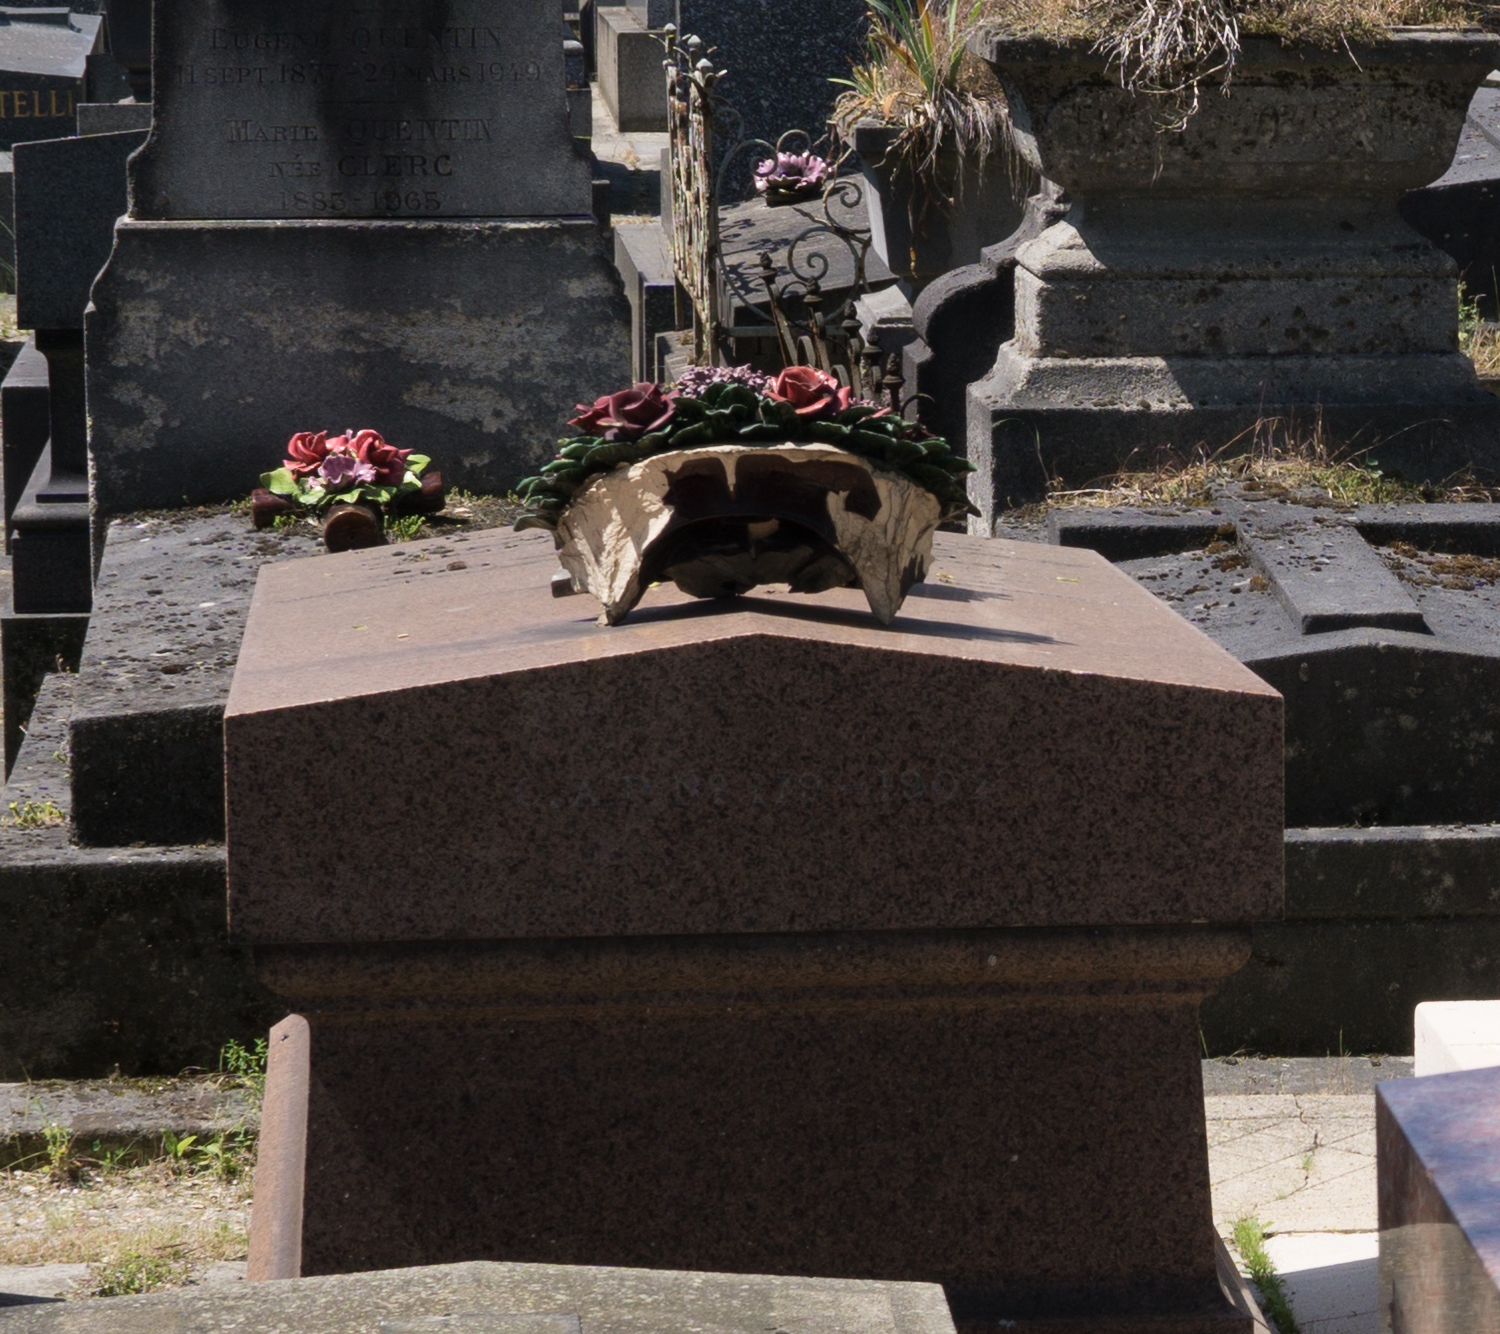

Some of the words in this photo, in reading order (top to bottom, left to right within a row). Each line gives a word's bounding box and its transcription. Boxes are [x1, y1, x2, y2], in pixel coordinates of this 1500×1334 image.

[351, 25, 503, 54] QUENTIN
[225, 118, 319, 143] MARIE
[345, 118, 493, 147] QUENTIN
[336, 153, 453, 178] CLERC
